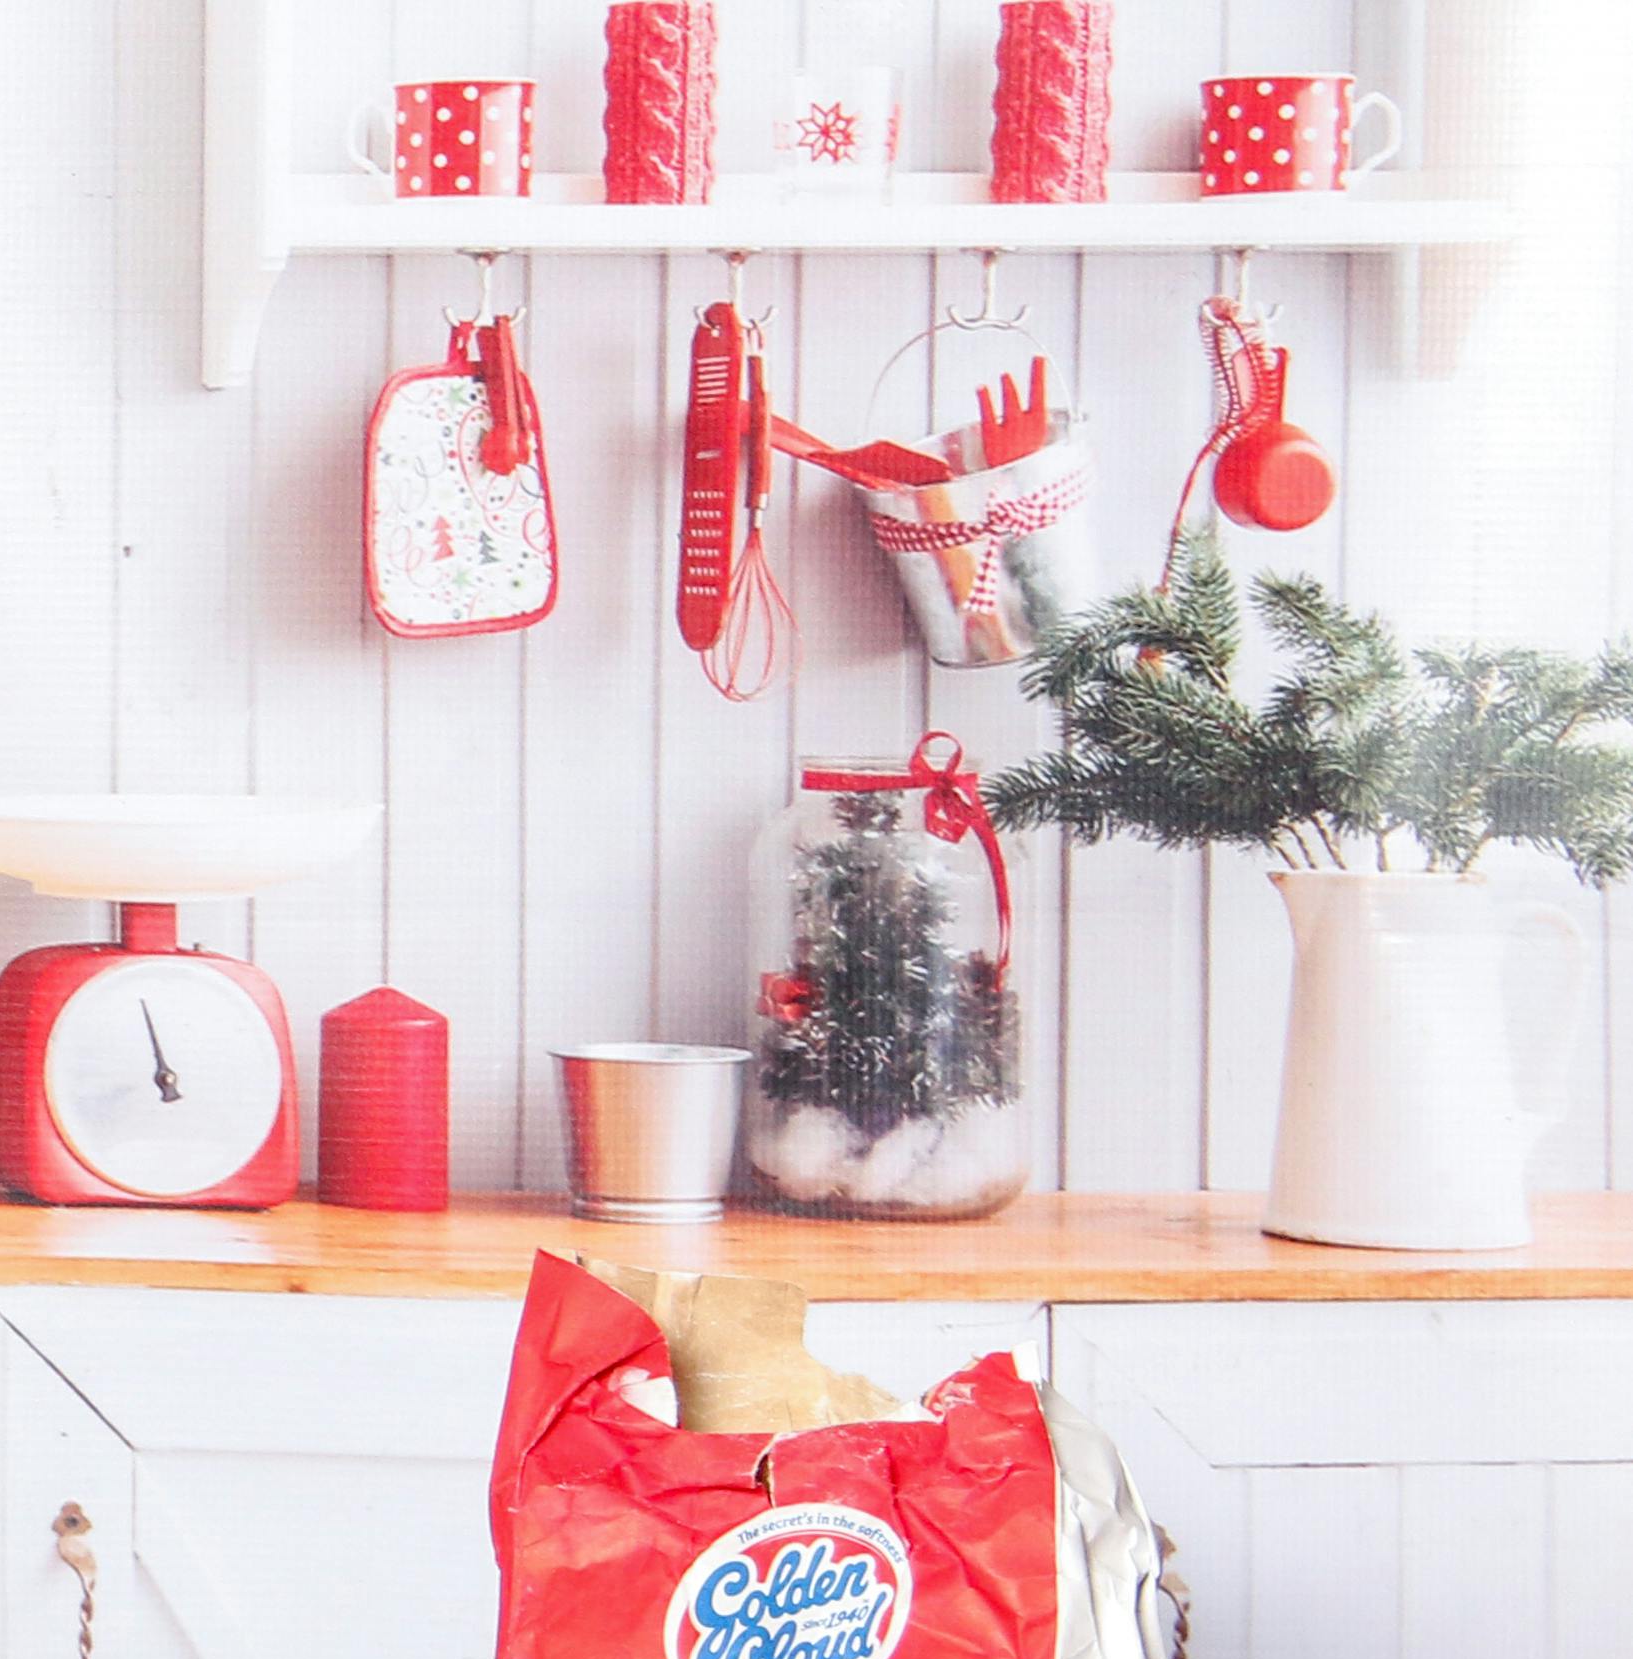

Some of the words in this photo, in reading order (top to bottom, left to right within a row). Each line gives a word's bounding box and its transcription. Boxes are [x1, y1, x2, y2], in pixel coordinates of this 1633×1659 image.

[738, 1525, 758, 1544] The
[762, 1512, 813, 1533] secret's
[817, 1513, 830, 1525] in
[833, 1513, 854, 1530] the
[856, 1523, 904, 1564] softness
[826, 1605, 869, 1629] 1940
